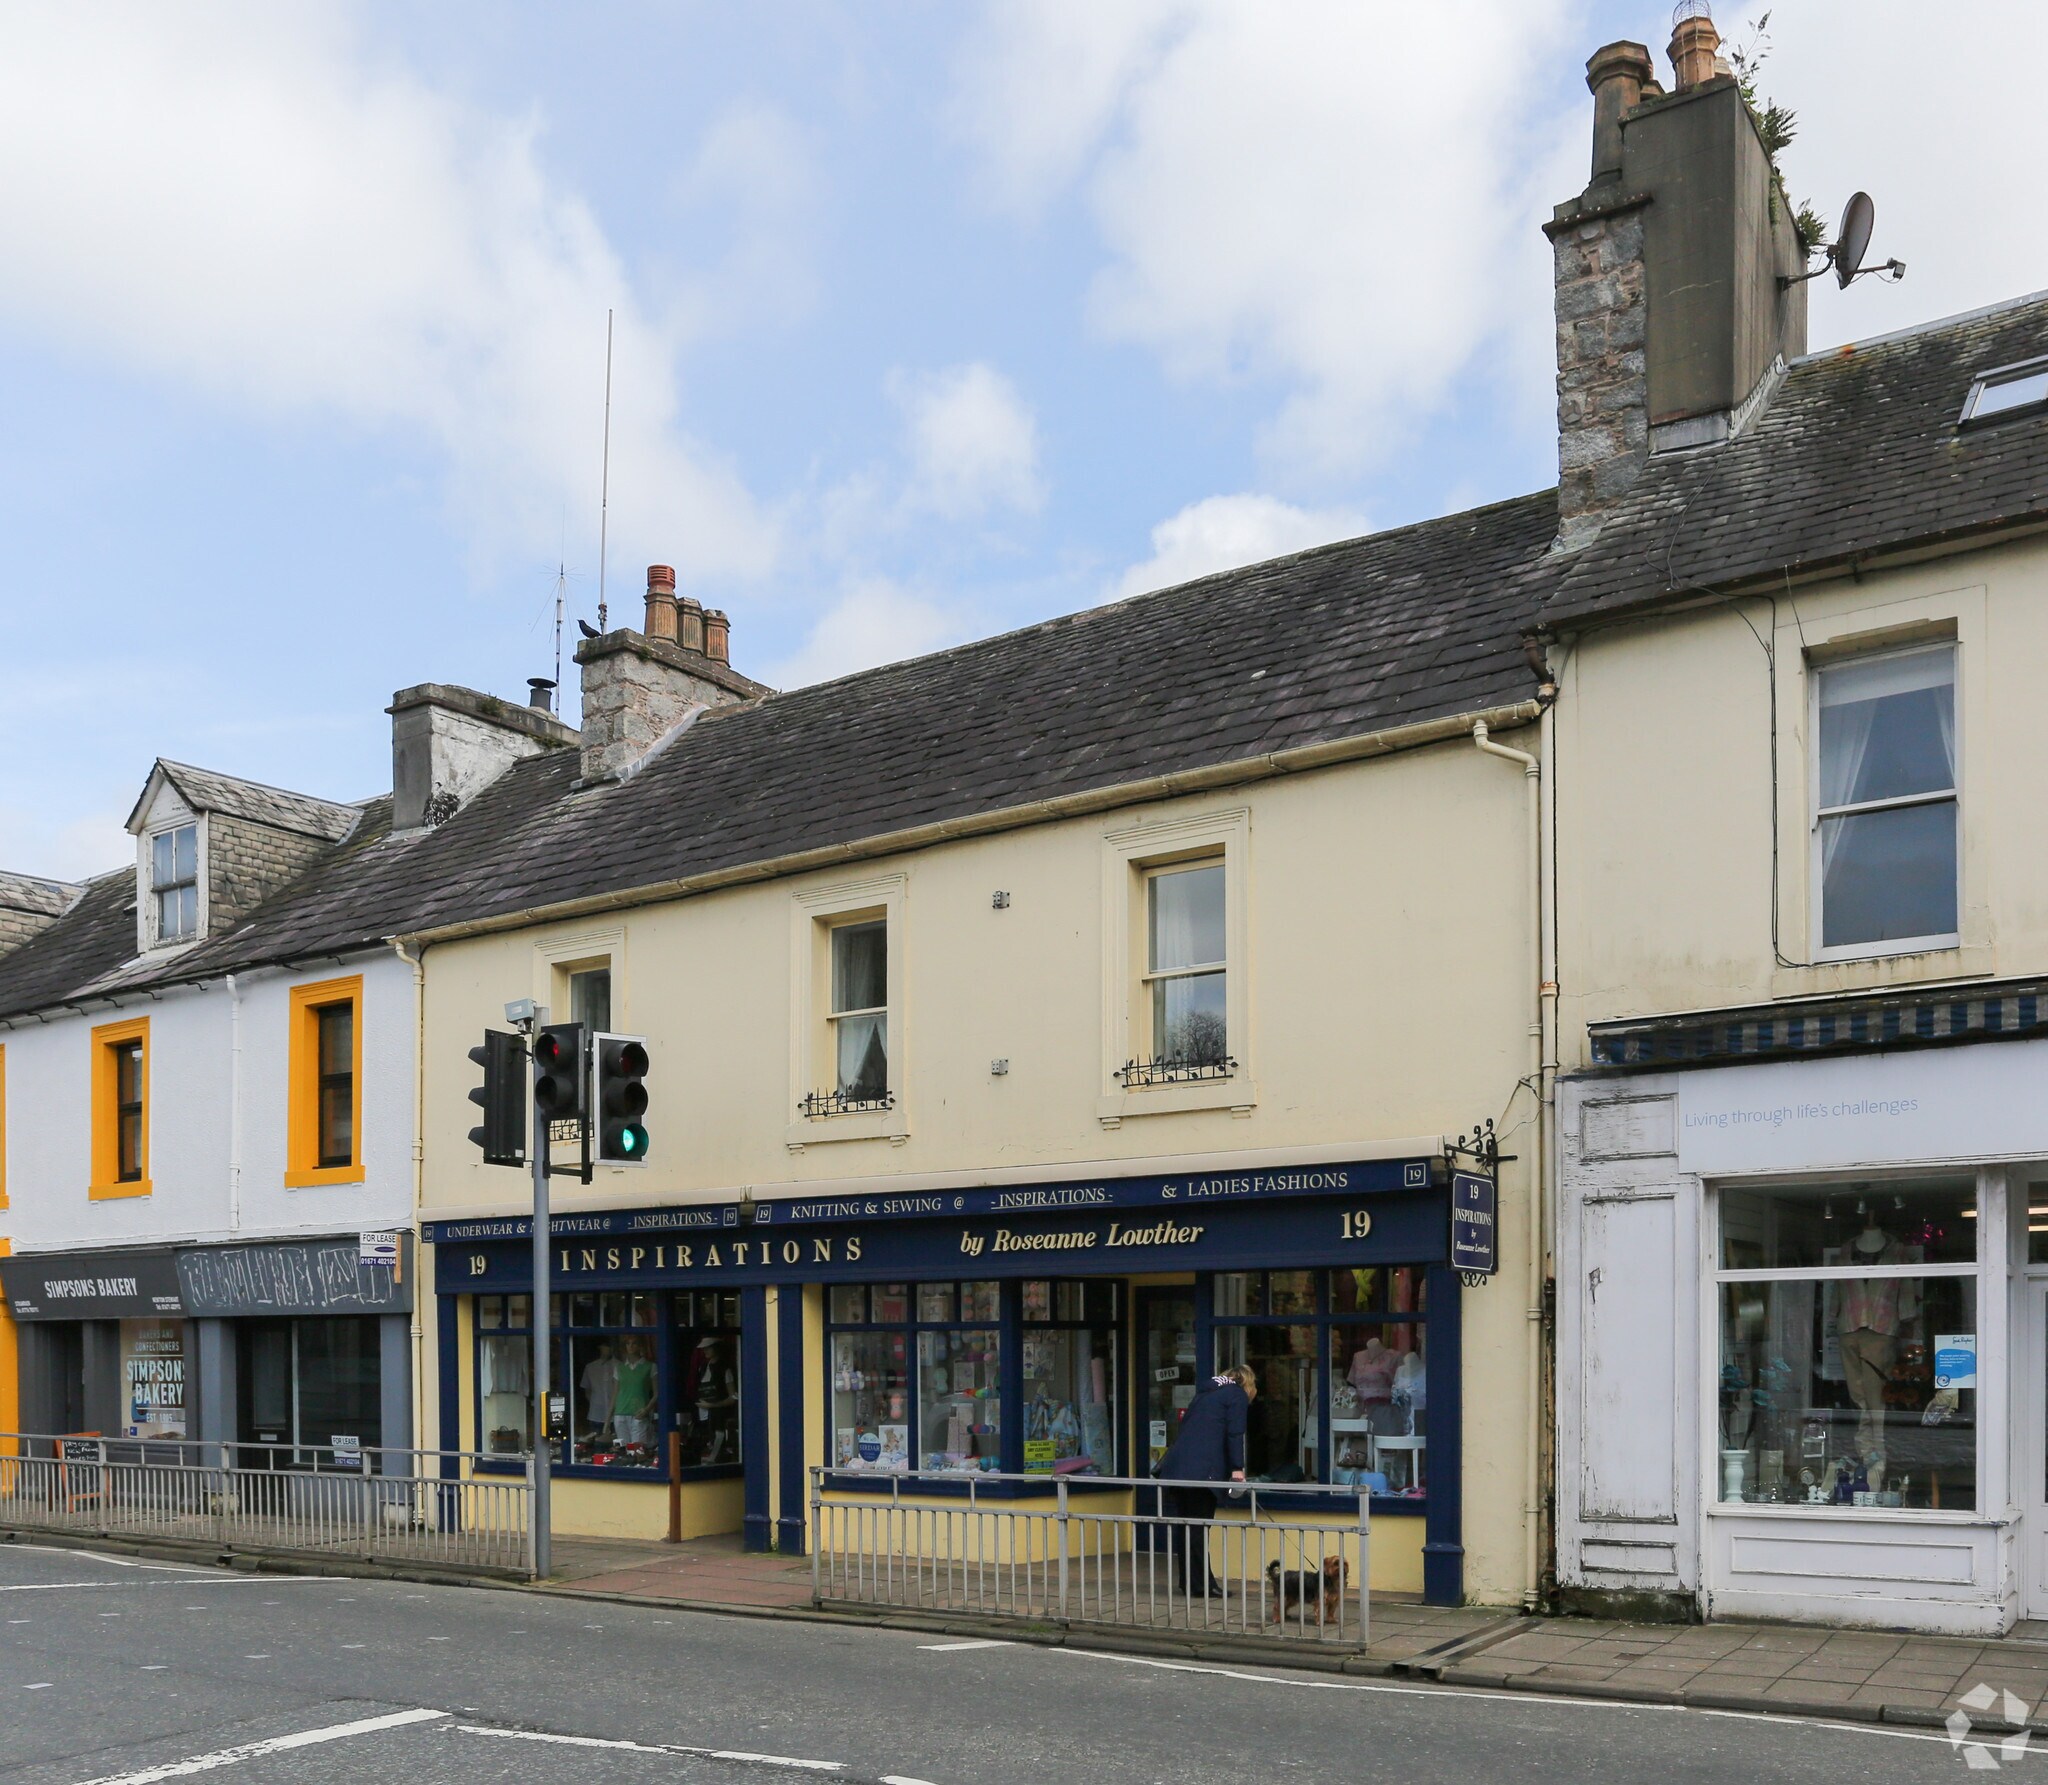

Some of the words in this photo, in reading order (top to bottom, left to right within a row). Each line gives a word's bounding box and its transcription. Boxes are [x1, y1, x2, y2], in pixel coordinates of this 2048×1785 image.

[1684, 1112, 1729, 1128] Living
[1732, 1106, 1793, 1124] through
[1797, 1102, 1828, 1119] life's
[1832, 1098, 1919, 1116] challenges
[1408, 1168, 1422, 1181] 19
[791, 1202, 860, 1218] KNITTING
[865, 1202, 878, 1214] &
[884, 1198, 942, 1213] SEWING
[954, 1196, 965, 1209] @
[1161, 1184, 1177, 1198] &
[1188, 1177, 1250, 1197] LADIES
[1253, 1172, 1349, 1191] FASHIONS
[1469, 1184, 1479, 1199] 19
[725, 1212, 735, 1222] 19
[759, 1208, 769, 1219] 19
[1455, 1208, 1492, 1226] INSPIRATIONS
[447, 1223, 513, 1238] UNDERWEAR
[516, 1222, 527, 1234] &
[530, 1219, 601, 1233] HTWEAR
[602, 1217, 612, 1230] @
[1341, 1210, 1372, 1239] 19
[362, 1233, 376, 1243] FOR
[377, 1234, 396, 1243] LEASE
[1471, 1228, 1477, 1239] by
[560, 1237, 862, 1272] INSPIRATIONS
[960, 1231, 985, 1256] by
[992, 1228, 1097, 1252] Roseanne
[1105, 1220, 1204, 1247] Lowther
[469, 1254, 487, 1275] 19
[44, 1278, 97, 1299] SIMPSONS
[97, 1277, 139, 1297] BAKERY
[162, 1328, 175, 1338] AND
[134, 1341, 180, 1352] CONFECTIONERS
[1159, 1368, 1176, 1379] OPEN
[135, 1383, 184, 1405] BAKERY
[332, 1437, 342, 1445] FOR
[342, 1437, 357, 1446] LEASE
